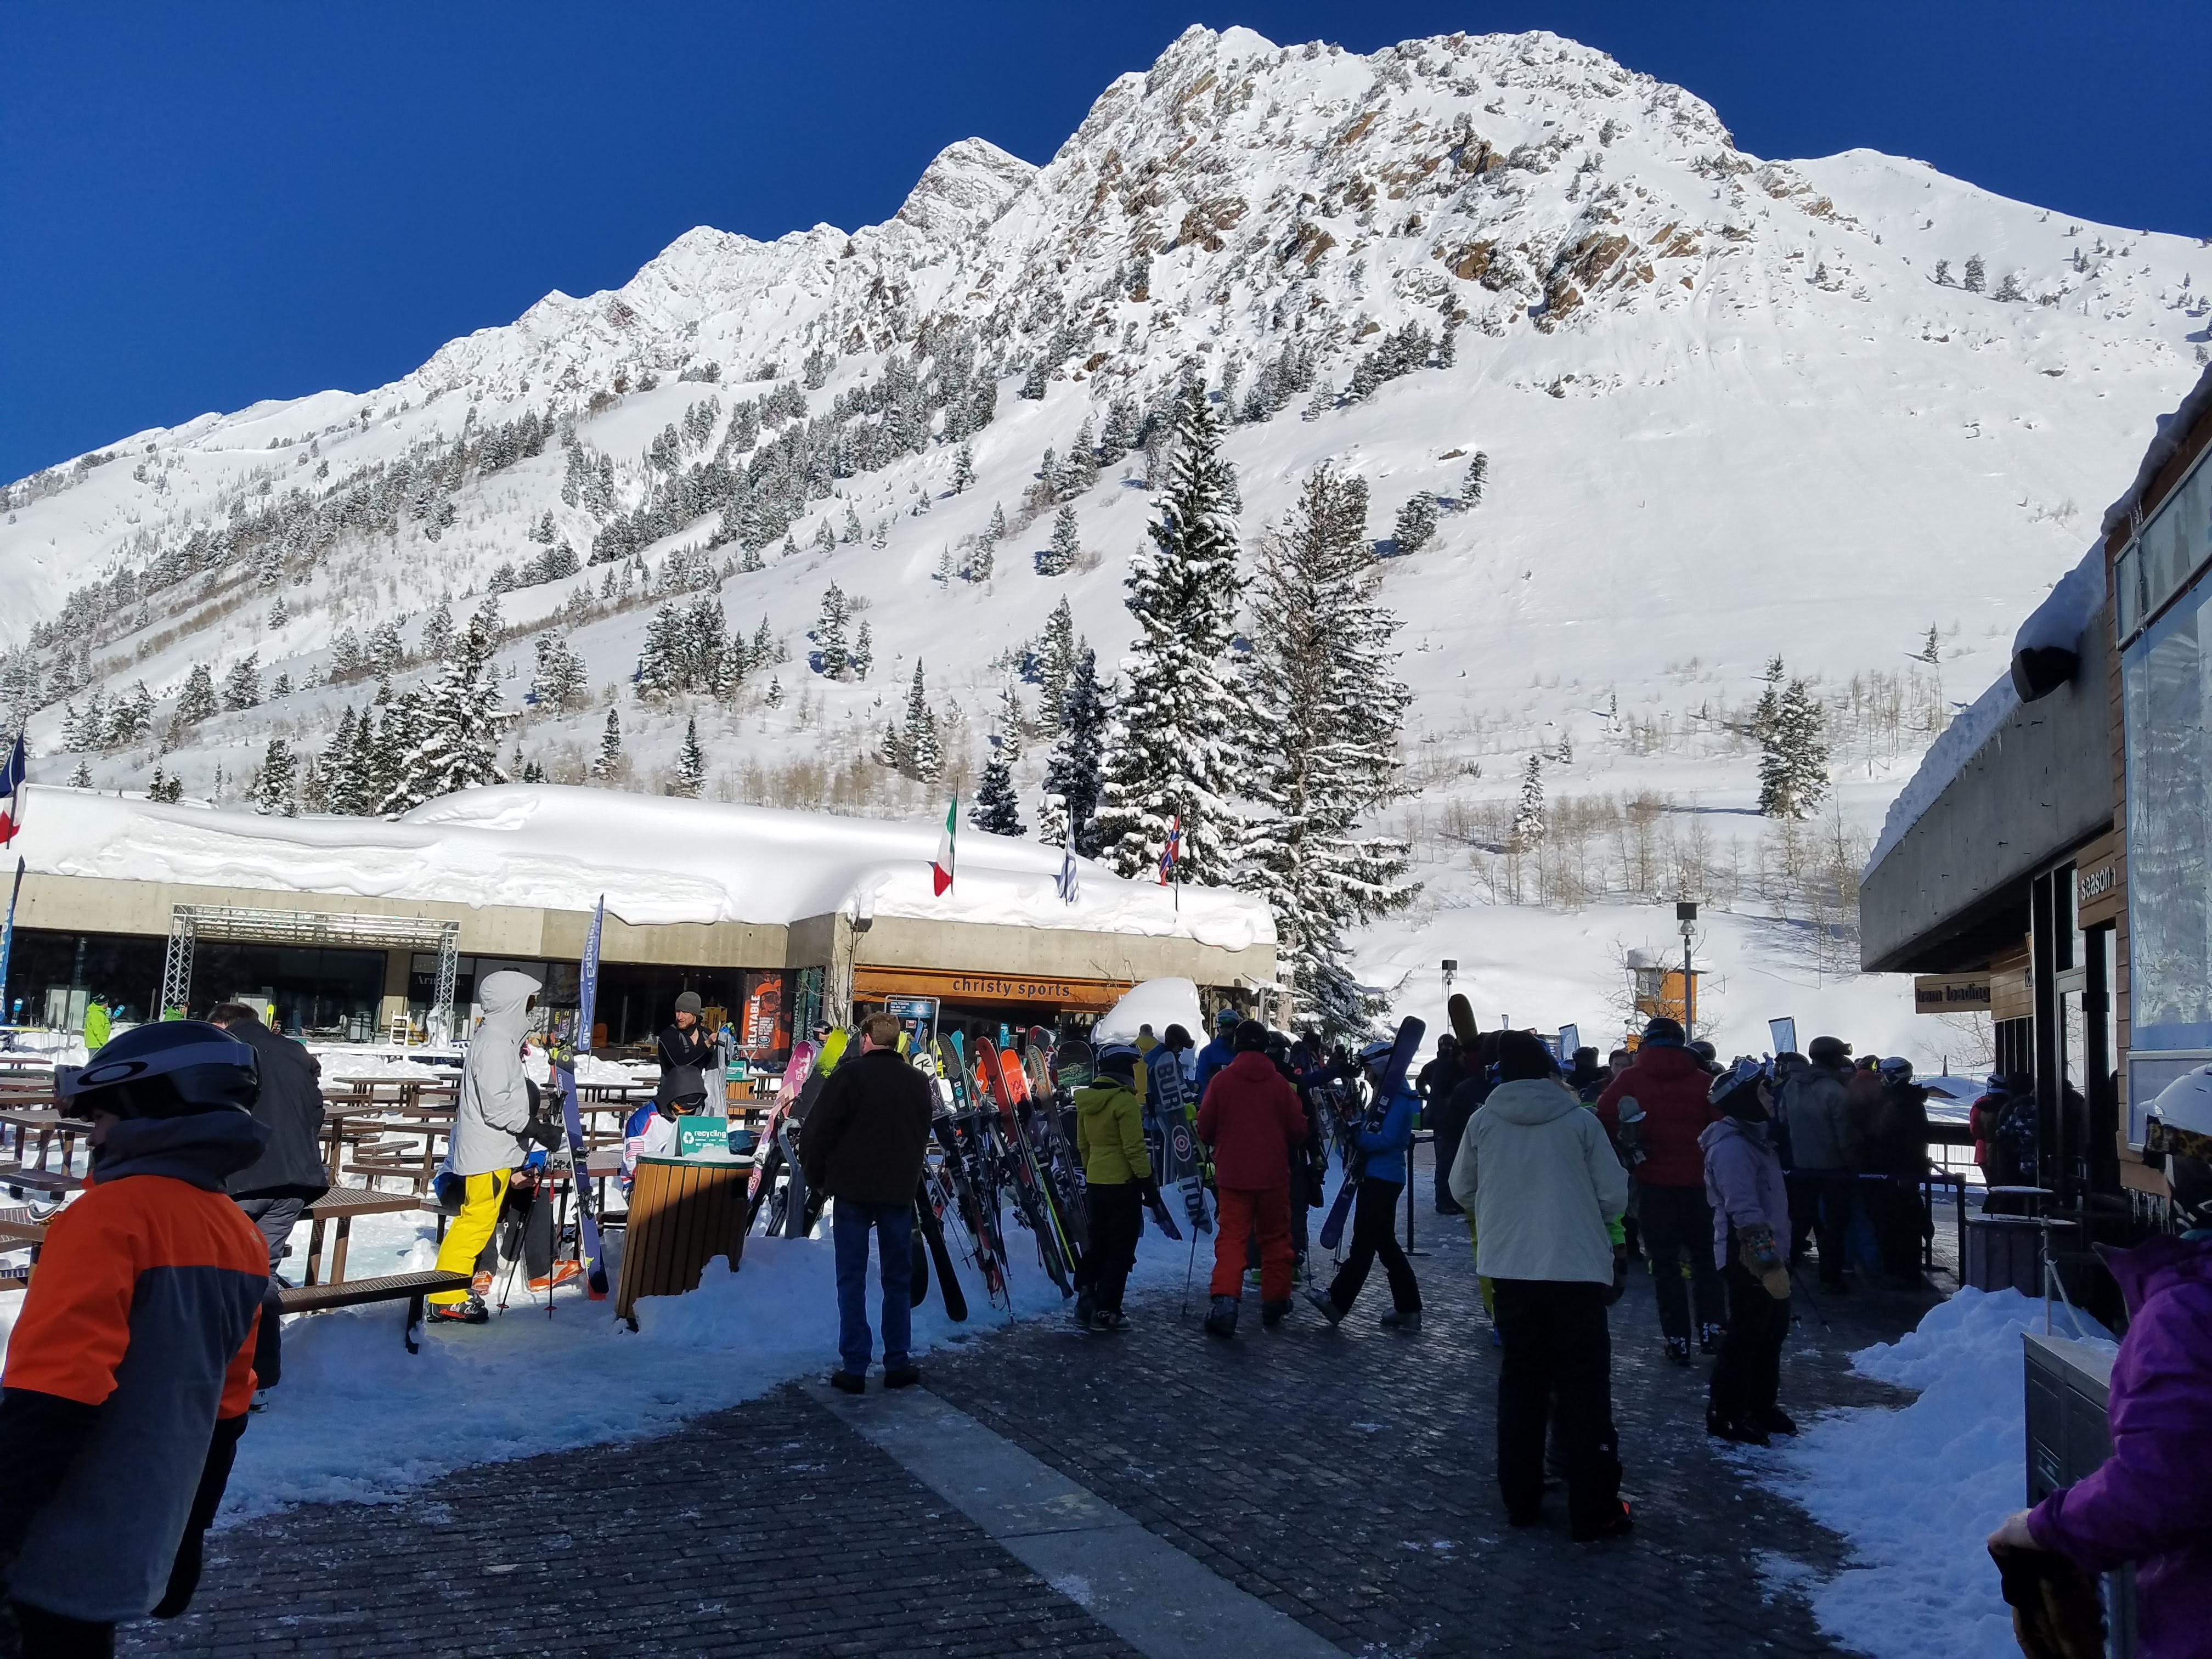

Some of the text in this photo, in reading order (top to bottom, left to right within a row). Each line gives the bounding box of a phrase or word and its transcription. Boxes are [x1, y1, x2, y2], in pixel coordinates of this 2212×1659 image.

[2081, 866, 2110, 900] season
[953, 978, 1070, 998] christy sports
[1916, 983, 1990, 1002] tram loading
[694, 1130, 726, 1138] recycling
